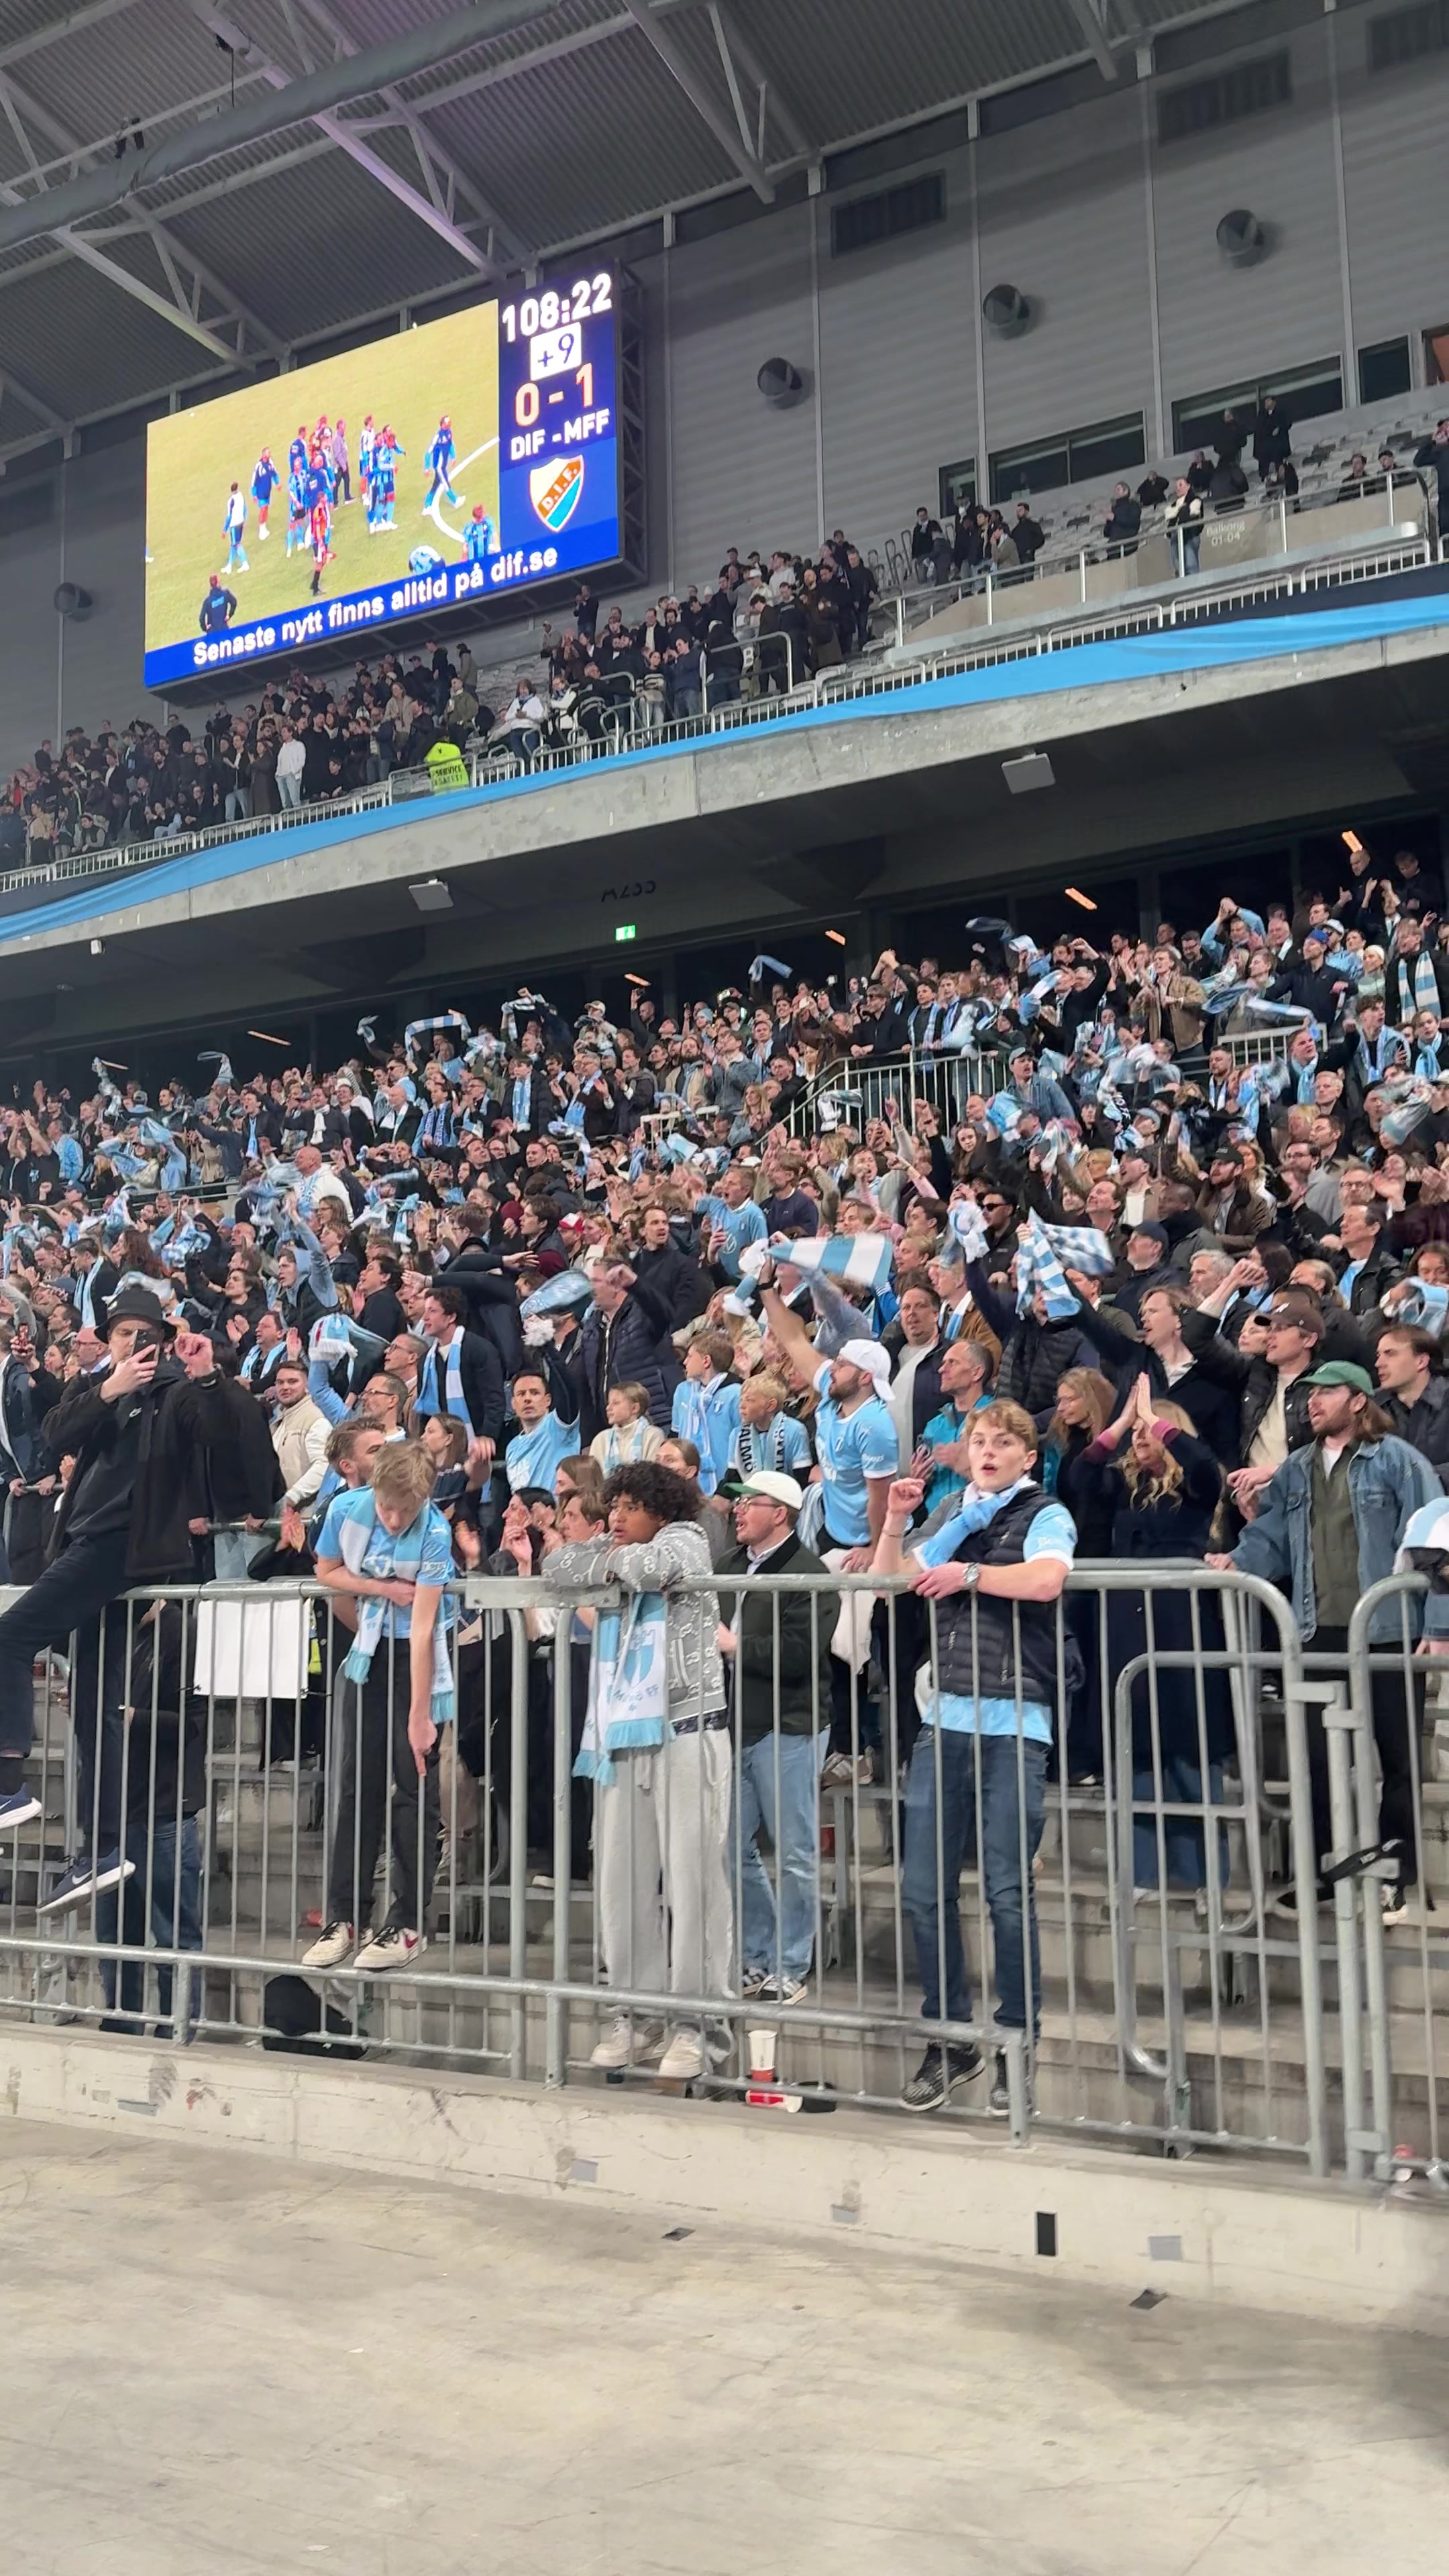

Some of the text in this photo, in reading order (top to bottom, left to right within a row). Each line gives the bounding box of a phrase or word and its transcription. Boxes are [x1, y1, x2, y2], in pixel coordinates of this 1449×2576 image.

[502, 273, 612, 343] 108:22
[516, 383, 539, 426] 0
[576, 362, 592, 407] 1
[511, 429, 545, 460] DIF
[194, 547, 557, 665] Senaste nytt finns alltid på dif.se
[739, 1424, 757, 1472] ALMÖ
